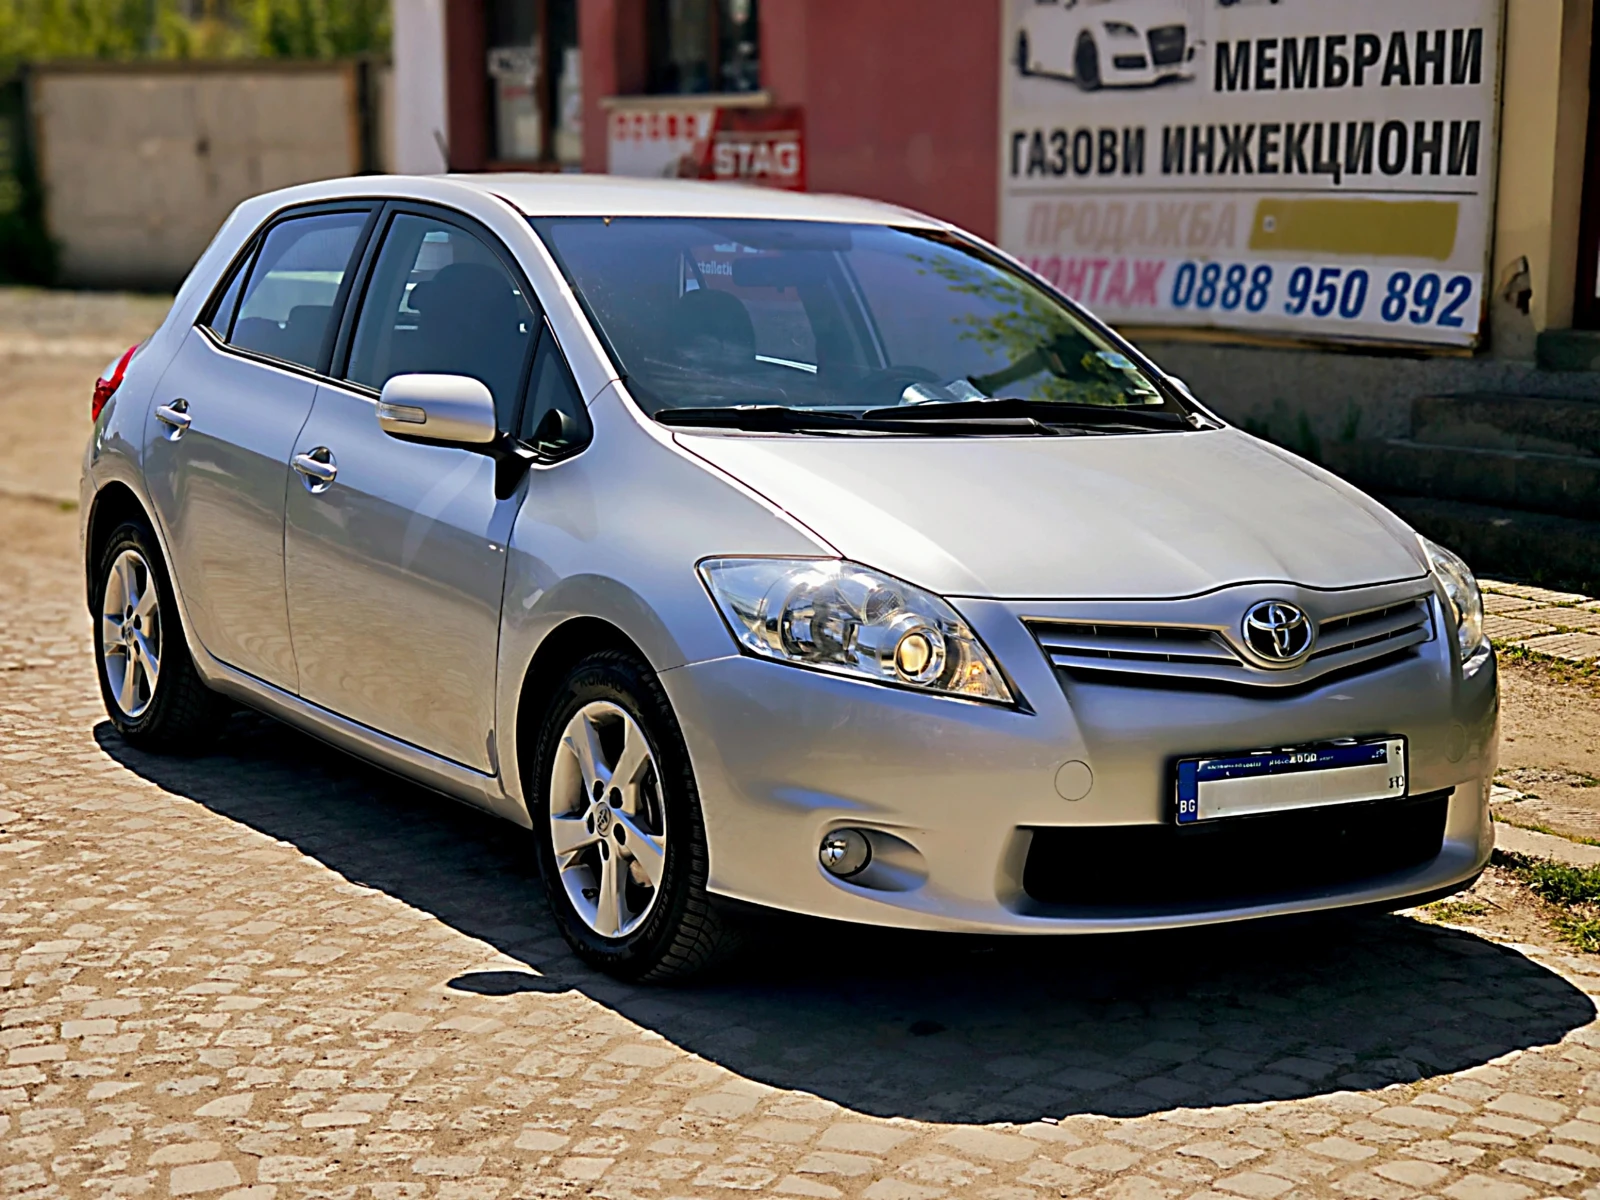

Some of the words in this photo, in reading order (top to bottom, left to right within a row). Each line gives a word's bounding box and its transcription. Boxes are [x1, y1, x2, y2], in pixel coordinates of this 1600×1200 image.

[1214, 28, 1483, 92] МЕМБРАНИ
[714, 142, 800, 176] STAG
[1011, 126, 1145, 177] ГАЗОВИ
[1162, 120, 1480, 185] ИНЖЕКЦИОНИ
[1026, 202, 1238, 250] ПРОДАЖБА
[1171, 260, 1273, 312] 0888
[1284, 266, 1369, 319] 950
[1380, 271, 1472, 327] 892
[1180, 799, 1196, 814] BG
